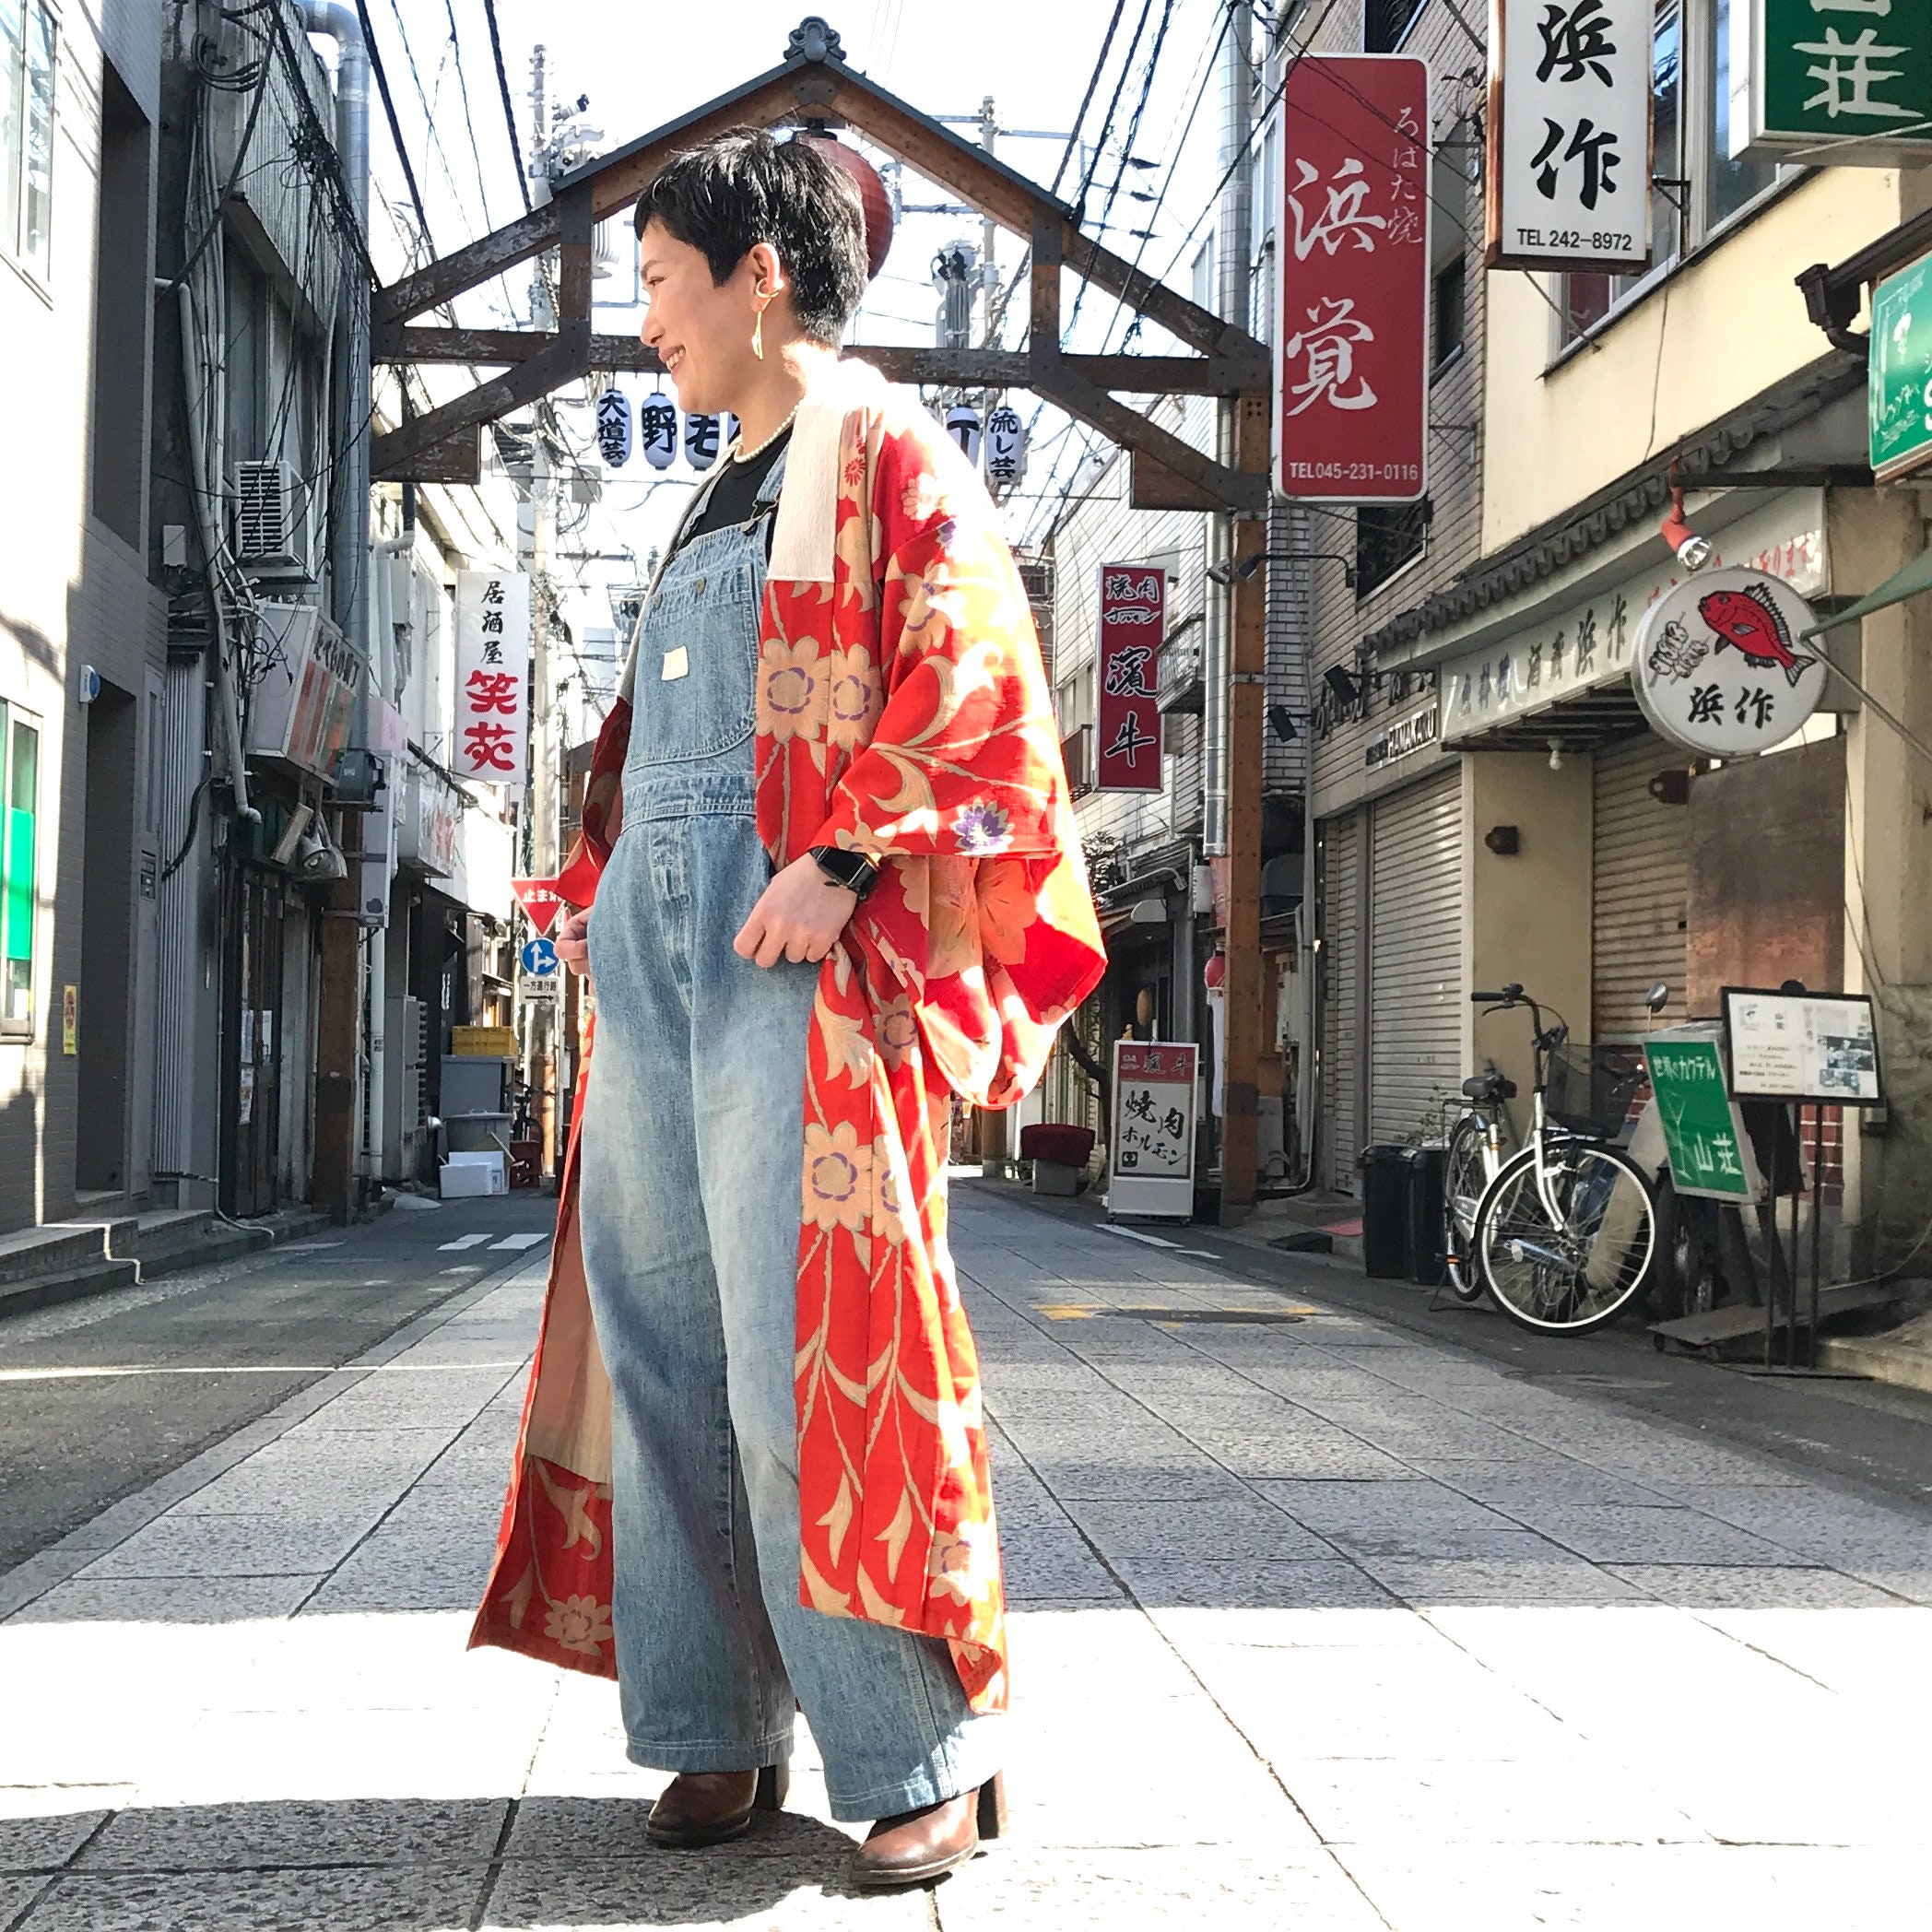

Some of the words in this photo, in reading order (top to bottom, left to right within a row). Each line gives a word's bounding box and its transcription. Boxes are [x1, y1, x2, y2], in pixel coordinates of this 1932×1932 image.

[1792, 0, 1925, 118] 荘
[1530, 0, 1621, 210] 浜作
[1388, 107, 1423, 245] ろばた焼
[1517, 229, 1546, 246] TEL
[1549, 230, 1632, 252] 242-8972
[1287, 158, 1386, 416] 浜覚
[598, 395, 629, 460] 大道芸
[990, 411, 1019, 478] 流し芸
[1105, 574, 1160, 603] 焼肉
[480, 581, 505, 665] 居酒屋
[464, 670, 519, 772] 笑苑
[1104, 646, 1159, 767] 濱牛
[1688, 683, 1774, 729] 浜作
[1121, 1126, 1187, 1166] ホルモン
[1125, 1090, 1185, 1140] 焼肉
[1694, 1132, 1743, 1176] 山荘
